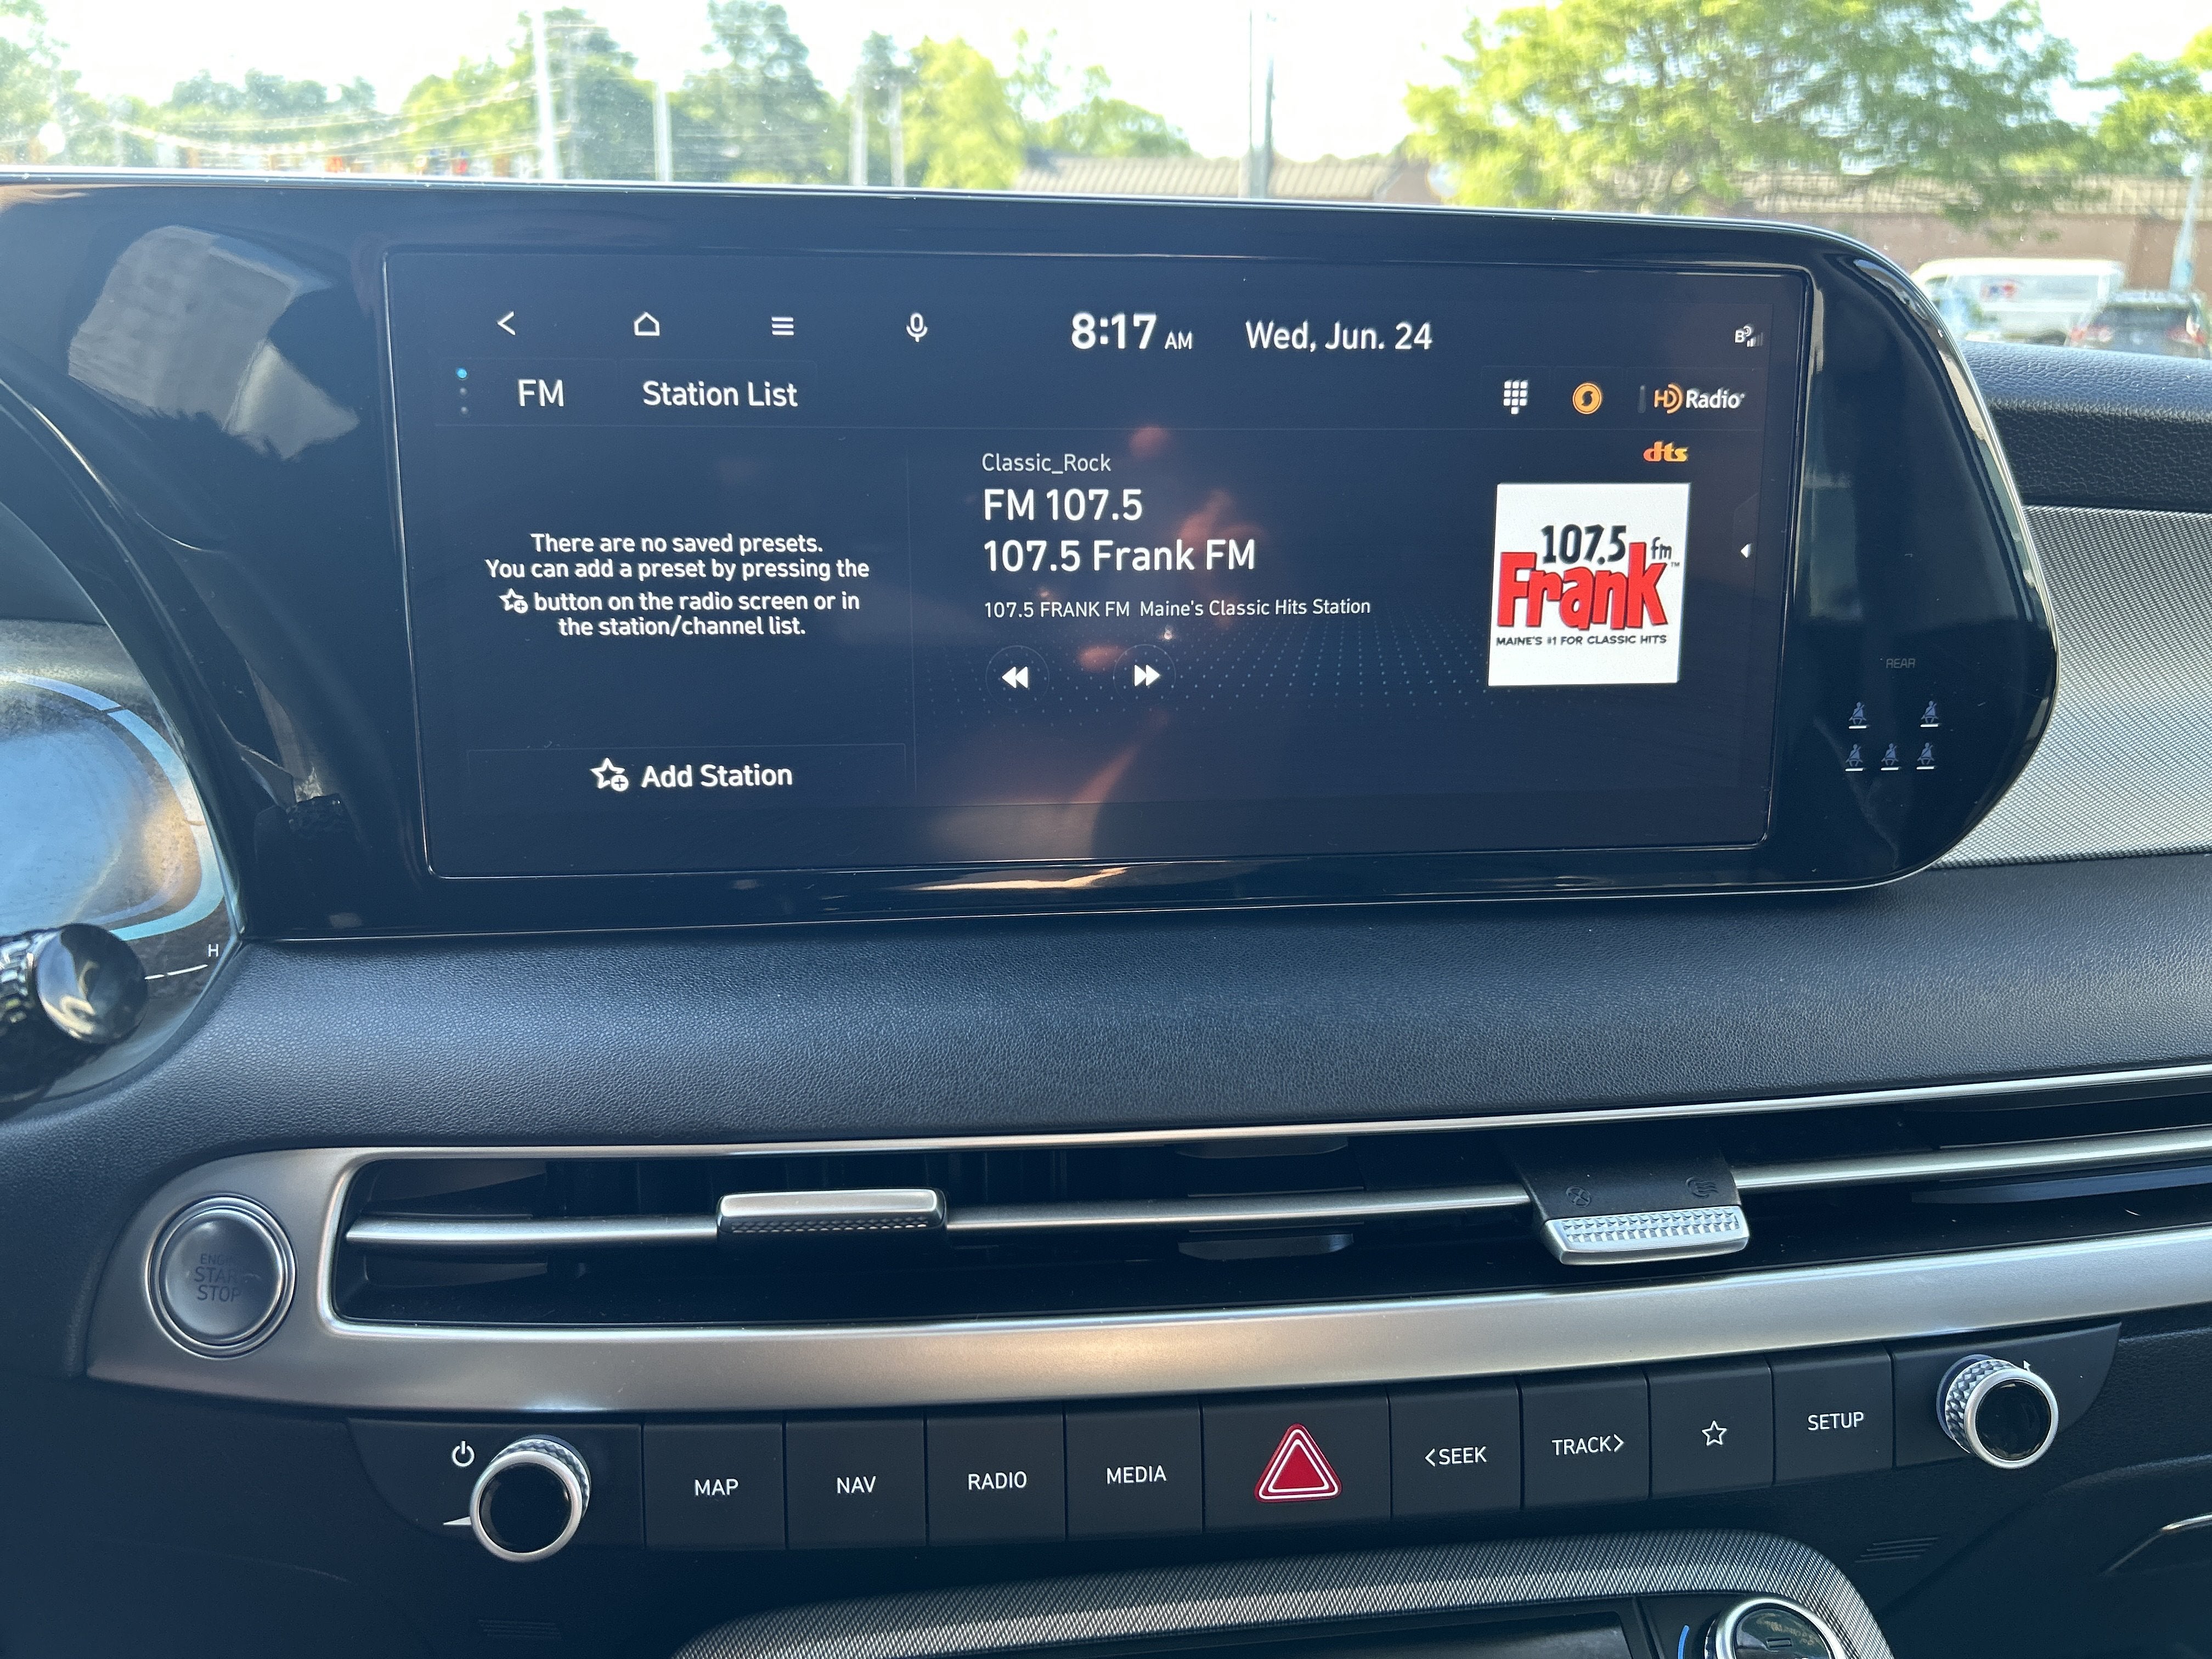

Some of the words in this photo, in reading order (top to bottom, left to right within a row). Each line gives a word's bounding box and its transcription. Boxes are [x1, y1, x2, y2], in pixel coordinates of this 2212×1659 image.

[1071, 312, 1157, 349] 8:17
[1164, 331, 1193, 350] AM
[1245, 320, 1317, 353] Wed,
[1324, 321, 1385, 350] Jun.
[1395, 321, 1433, 350] 24
[518, 379, 564, 407] FM
[642, 380, 739, 407] Station
[748, 381, 798, 407] List
[1644, 441, 1689, 462] dts
[982, 453, 1111, 475] Classic_Rock
[984, 488, 1034, 521] FM
[1046, 488, 1143, 521] 107.5
[530, 533, 594, 552] There
[599, 537, 635, 552] are
[640, 537, 667, 552] no
[672, 533, 733, 552] saved
[739, 534, 823, 556] presets.
[984, 539, 1081, 572] 107.5
[1093, 538, 1195, 571] Frank
[1206, 539, 1255, 570] FM
[1541, 524, 1627, 565] 107.5
[1651, 537, 1672, 560] fm
[484, 559, 525, 578] You
[531, 563, 569, 578] can
[574, 558, 613, 578] add
[619, 562, 633, 578] a
[637, 559, 707, 582] preset
[711, 558, 736, 582] by
[742, 558, 831, 582] pressing
[836, 558, 870, 578] the
[1497, 541, 1668, 631] Frank
[534, 592, 603, 611] button
[607, 596, 634, 611] on
[638, 591, 674, 611] the
[679, 591, 733, 611] radio
[738, 595, 808, 610] screen
[814, 595, 836, 610] or
[842, 591, 860, 610] in
[985, 601, 1034, 618] 107.5
[1040, 601, 1101, 618] FRANK
[1105, 601, 1130, 617] FM
[1140, 600, 1204, 617] Maine's
[1209, 599, 1269, 616] Classic
[1276, 599, 1308, 615] Hits
[1312, 598, 1370, 614] Station
[558, 617, 594, 636] the
[598, 614, 764, 637] station/channel
[769, 616, 806, 635] list.
[1496, 636, 1543, 646] MAINE'S
[1560, 636, 1583, 645] FOR
[1587, 635, 1637, 645] CLASSIC
[1640, 634, 1667, 644] HITS
[1886, 658, 1916, 669] REAR
[640, 764, 693, 788] Add
[700, 763, 793, 787] Station
[208, 944, 219, 957] H
[197, 1284, 241, 1302] STOP
[1808, 1411, 1864, 1431] SETUP
[837, 1476, 876, 1494] NAV
[968, 1471, 1027, 1490] RADIO
[1107, 1465, 1167, 1485] MEDIA
[695, 1479, 739, 1496] MAP
